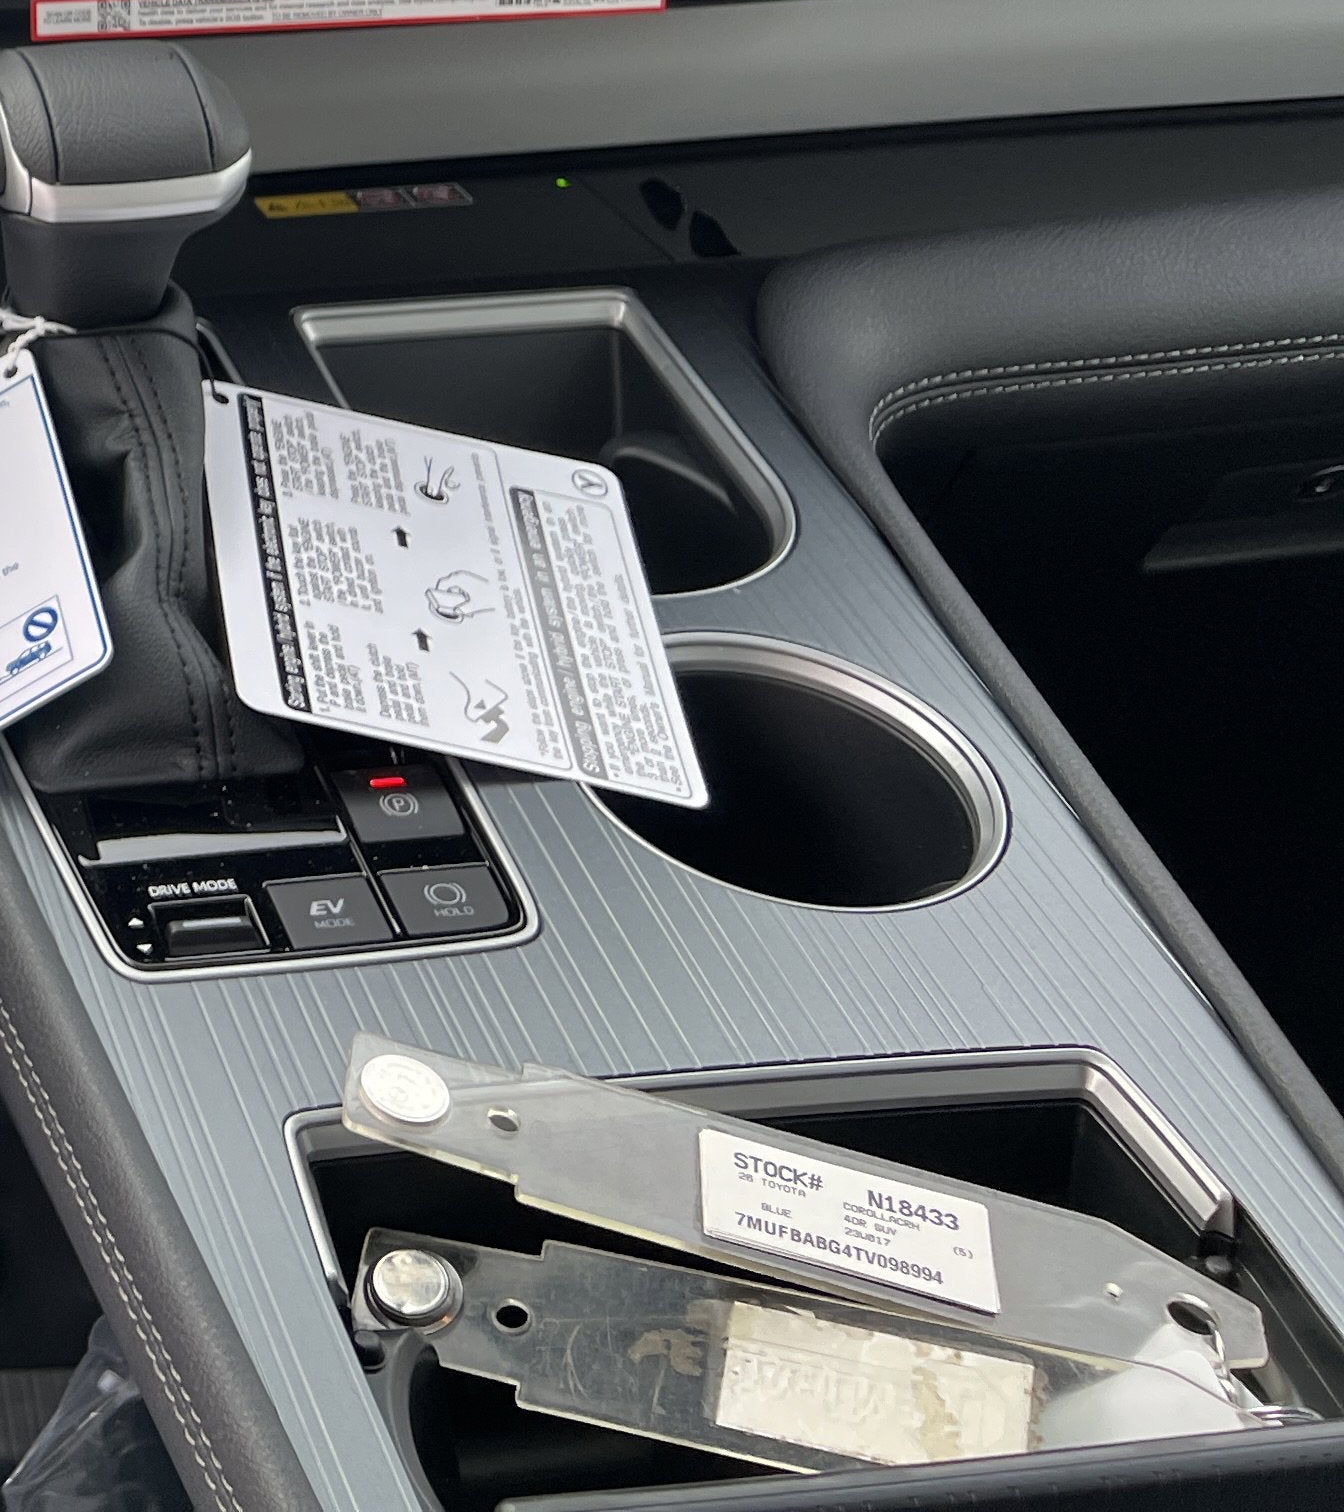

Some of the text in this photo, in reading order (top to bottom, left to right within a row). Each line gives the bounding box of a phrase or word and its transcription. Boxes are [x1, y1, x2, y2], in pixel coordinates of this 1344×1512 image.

[148, 878, 238, 898] DRIVE MODE
[310, 898, 344, 916] EV
[433, 905, 475, 918] HOLD
[314, 917, 355, 929] MODE
[733, 1152, 824, 1191] STOCK#
[762, 1178, 806, 1198] TOYOTA
[761, 1202, 792, 1219] BLUE
[867, 1190, 960, 1231] N18433
[844, 1215, 867, 1228] 4DR
[735, 1211, 943, 1285] 7MUFBABG4TV098994
